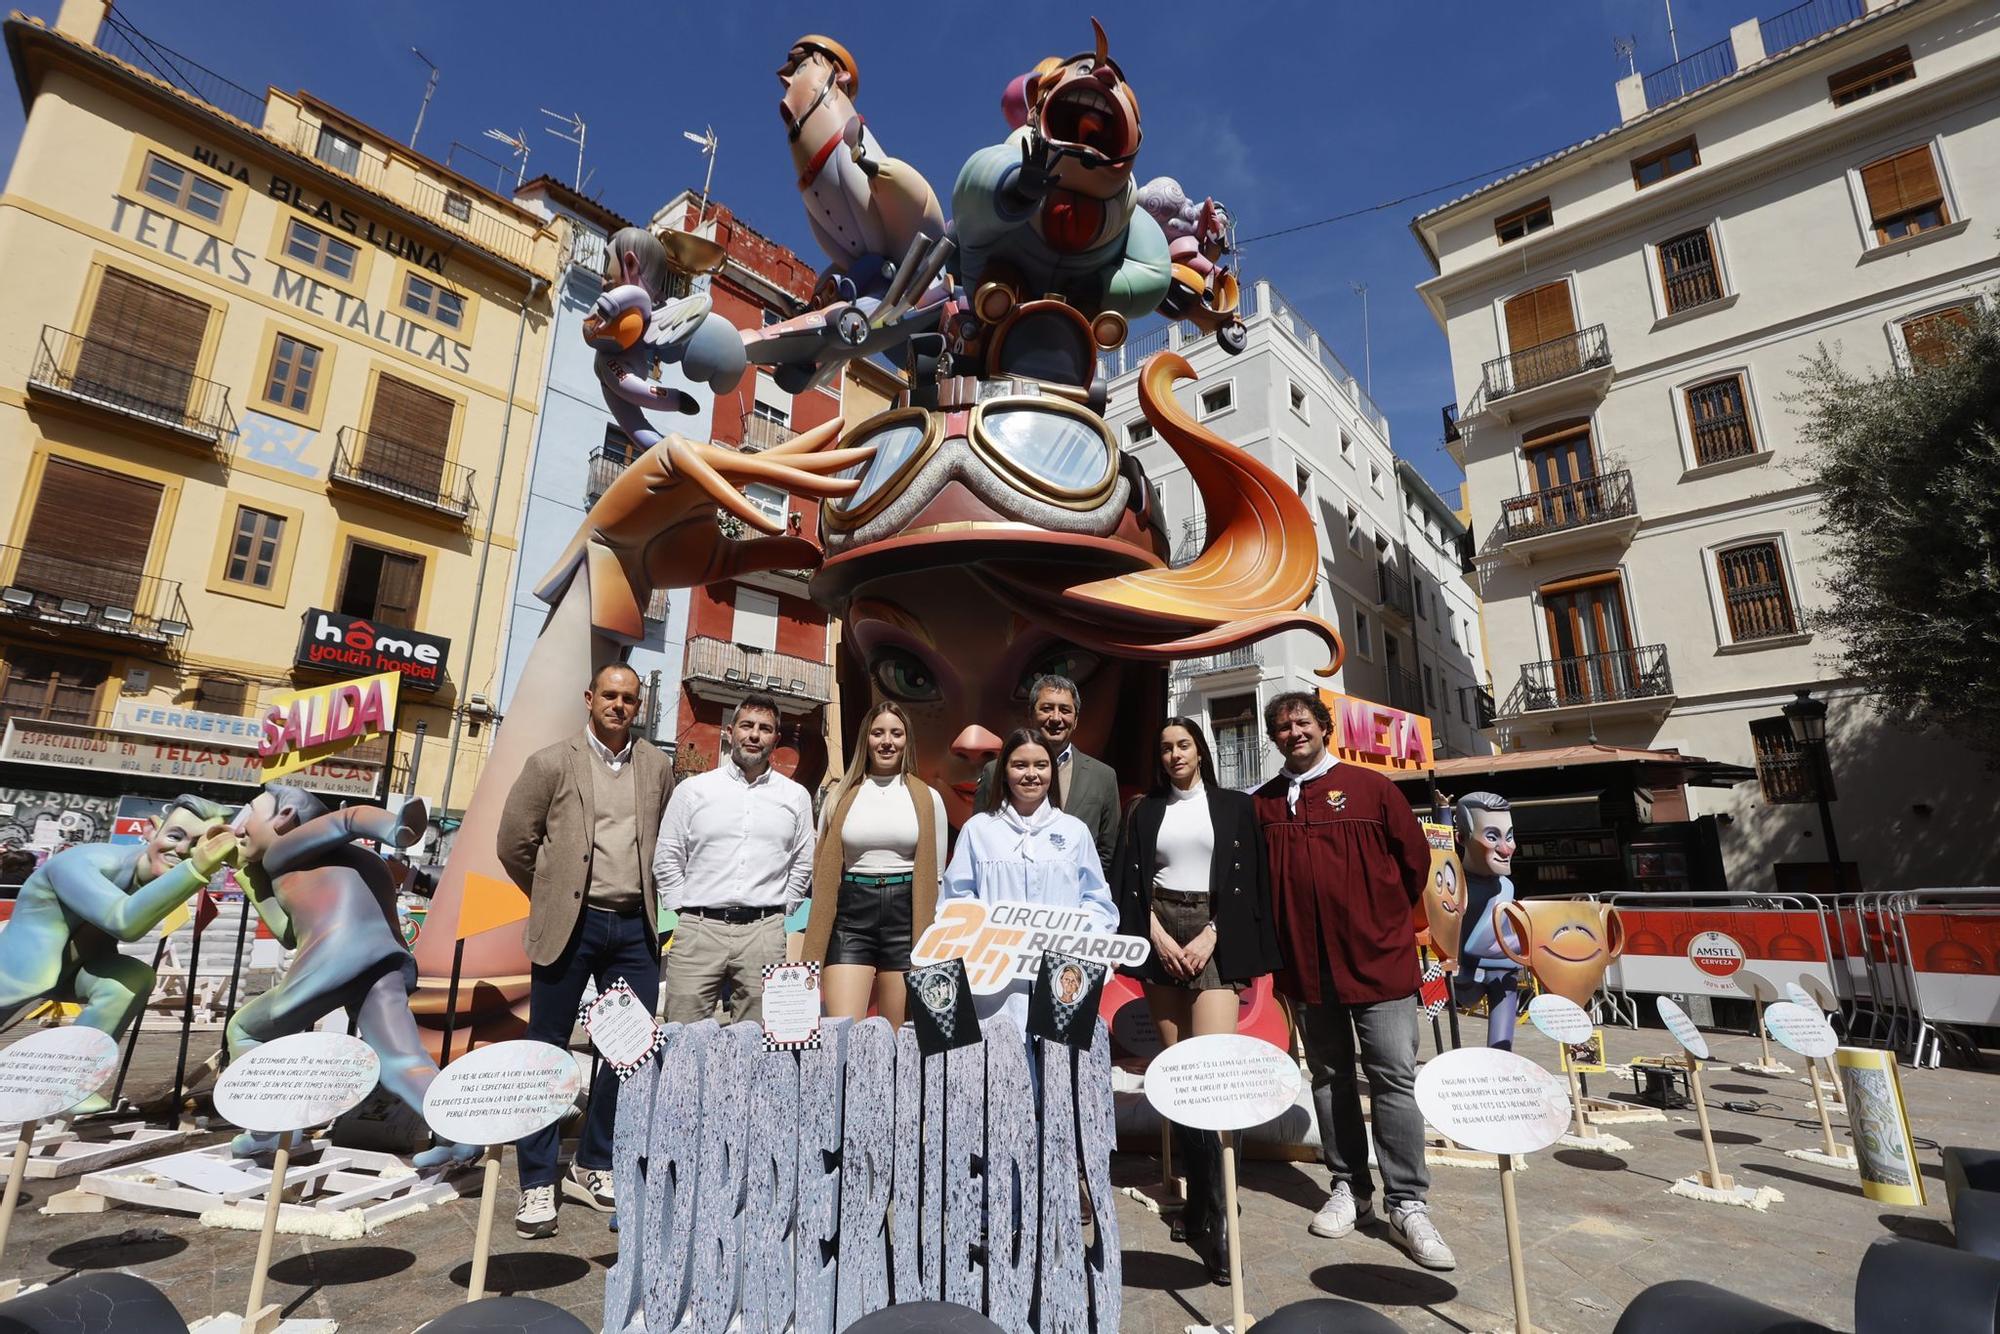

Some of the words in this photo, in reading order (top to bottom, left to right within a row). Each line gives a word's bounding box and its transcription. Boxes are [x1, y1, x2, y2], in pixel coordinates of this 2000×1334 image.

[193, 145, 250, 184] HIJA
[269, 175, 357, 234] BLAS
[365, 222, 451, 275] LUNA
[111, 194, 256, 286] TELAS
[272, 266, 472, 375] METALICAS
[309, 643, 372, 667] youth
[375, 653, 438, 681] hostel
[258, 679, 389, 757] SALIDA
[1337, 699, 1427, 763] META
[12, 750, 36, 761] PLAZA
[21, 732, 107, 754] ESPECIALIDAD
[121, 742, 137, 756] EN
[154, 740, 230, 766] TELAS
[244, 756, 373, 782] MLICAS
[172, 762, 206, 777] BLAS
[217, 766, 255, 783] LUNA
[990, 905, 1089, 932] CIRCUIT
[1027, 932, 1146, 962] RICARDO
[1696, 947, 1737, 957] AMSTEL
